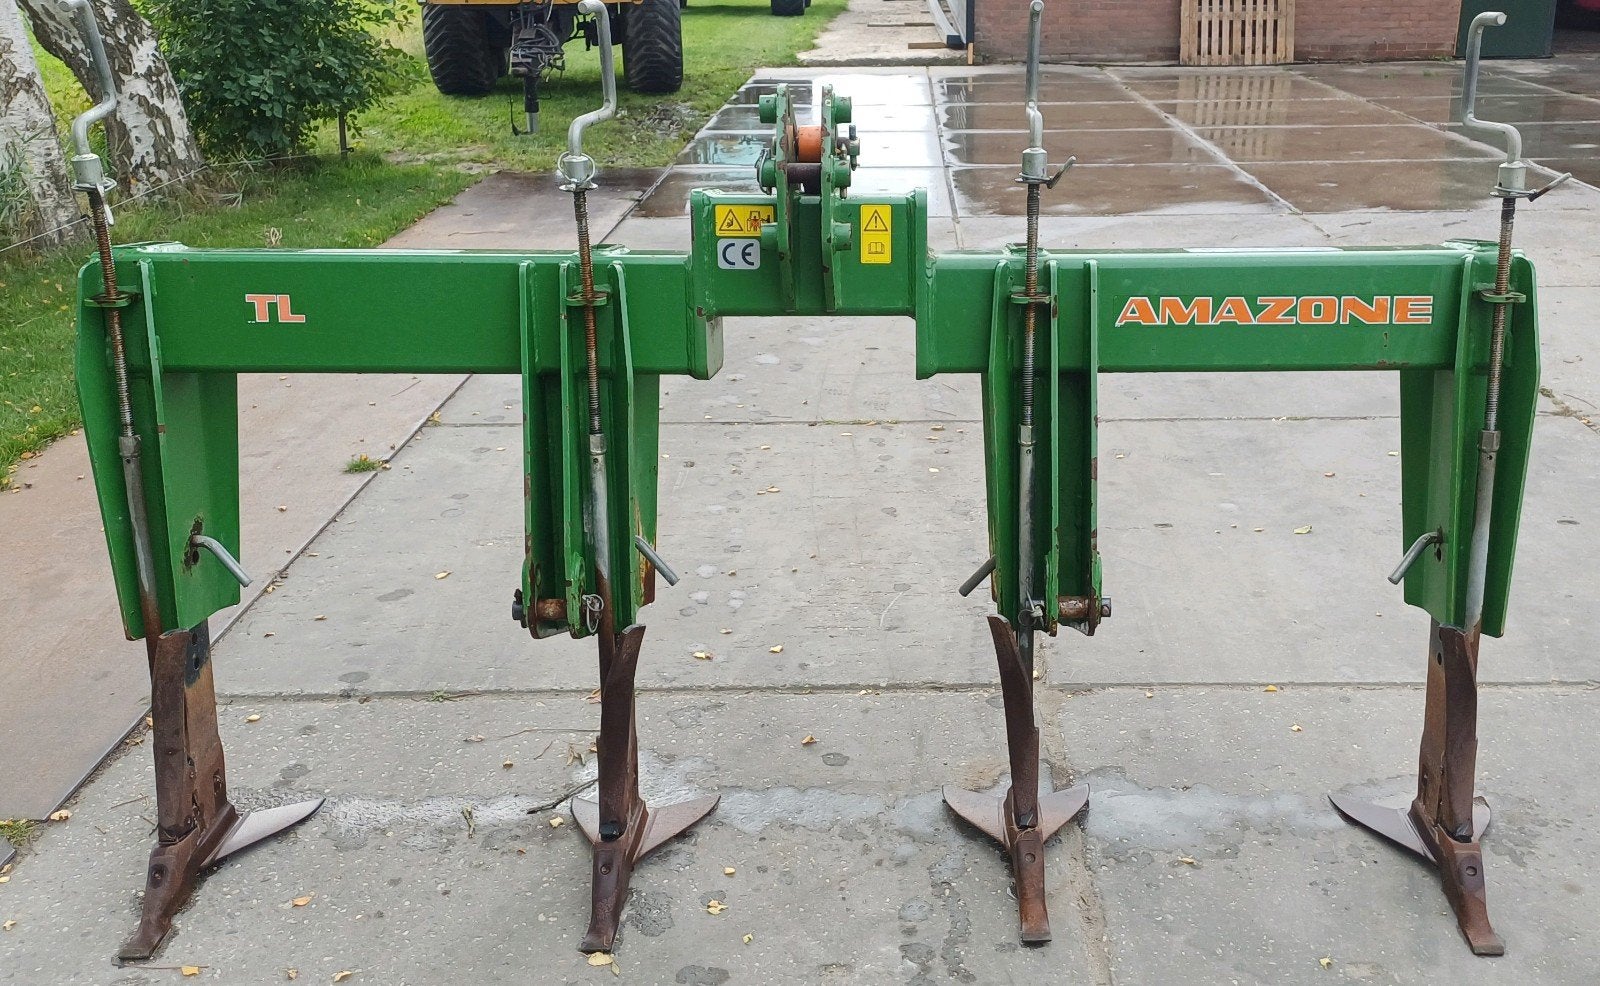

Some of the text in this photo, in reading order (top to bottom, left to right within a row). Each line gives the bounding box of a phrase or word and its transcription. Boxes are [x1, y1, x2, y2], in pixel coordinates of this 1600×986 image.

[722, 243, 754, 266] CE
[245, 294, 306, 323] TL
[1115, 296, 1434, 325] AMAZONE
